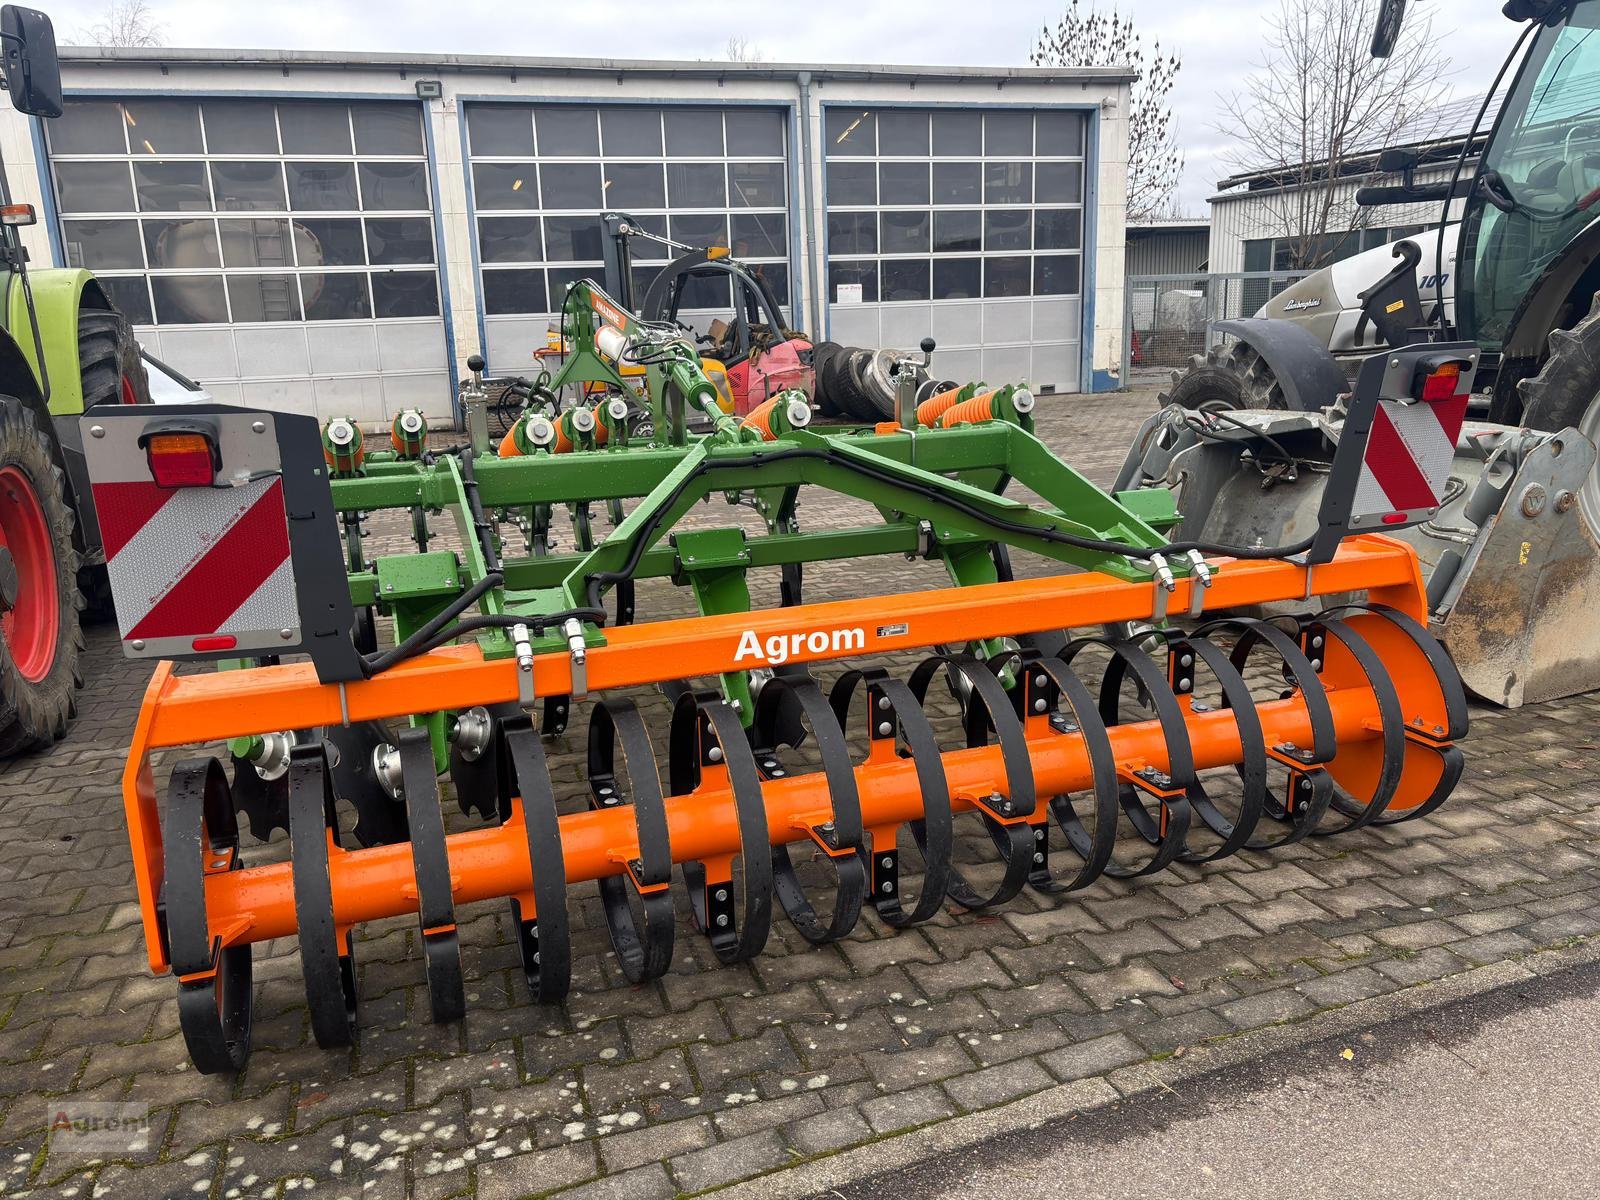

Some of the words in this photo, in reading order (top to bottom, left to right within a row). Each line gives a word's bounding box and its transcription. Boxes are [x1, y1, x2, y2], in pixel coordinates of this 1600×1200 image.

[1419, 273, 1450, 289] 100
[1283, 297, 1321, 311] Lamborghini
[733, 627, 865, 665] Agrom
